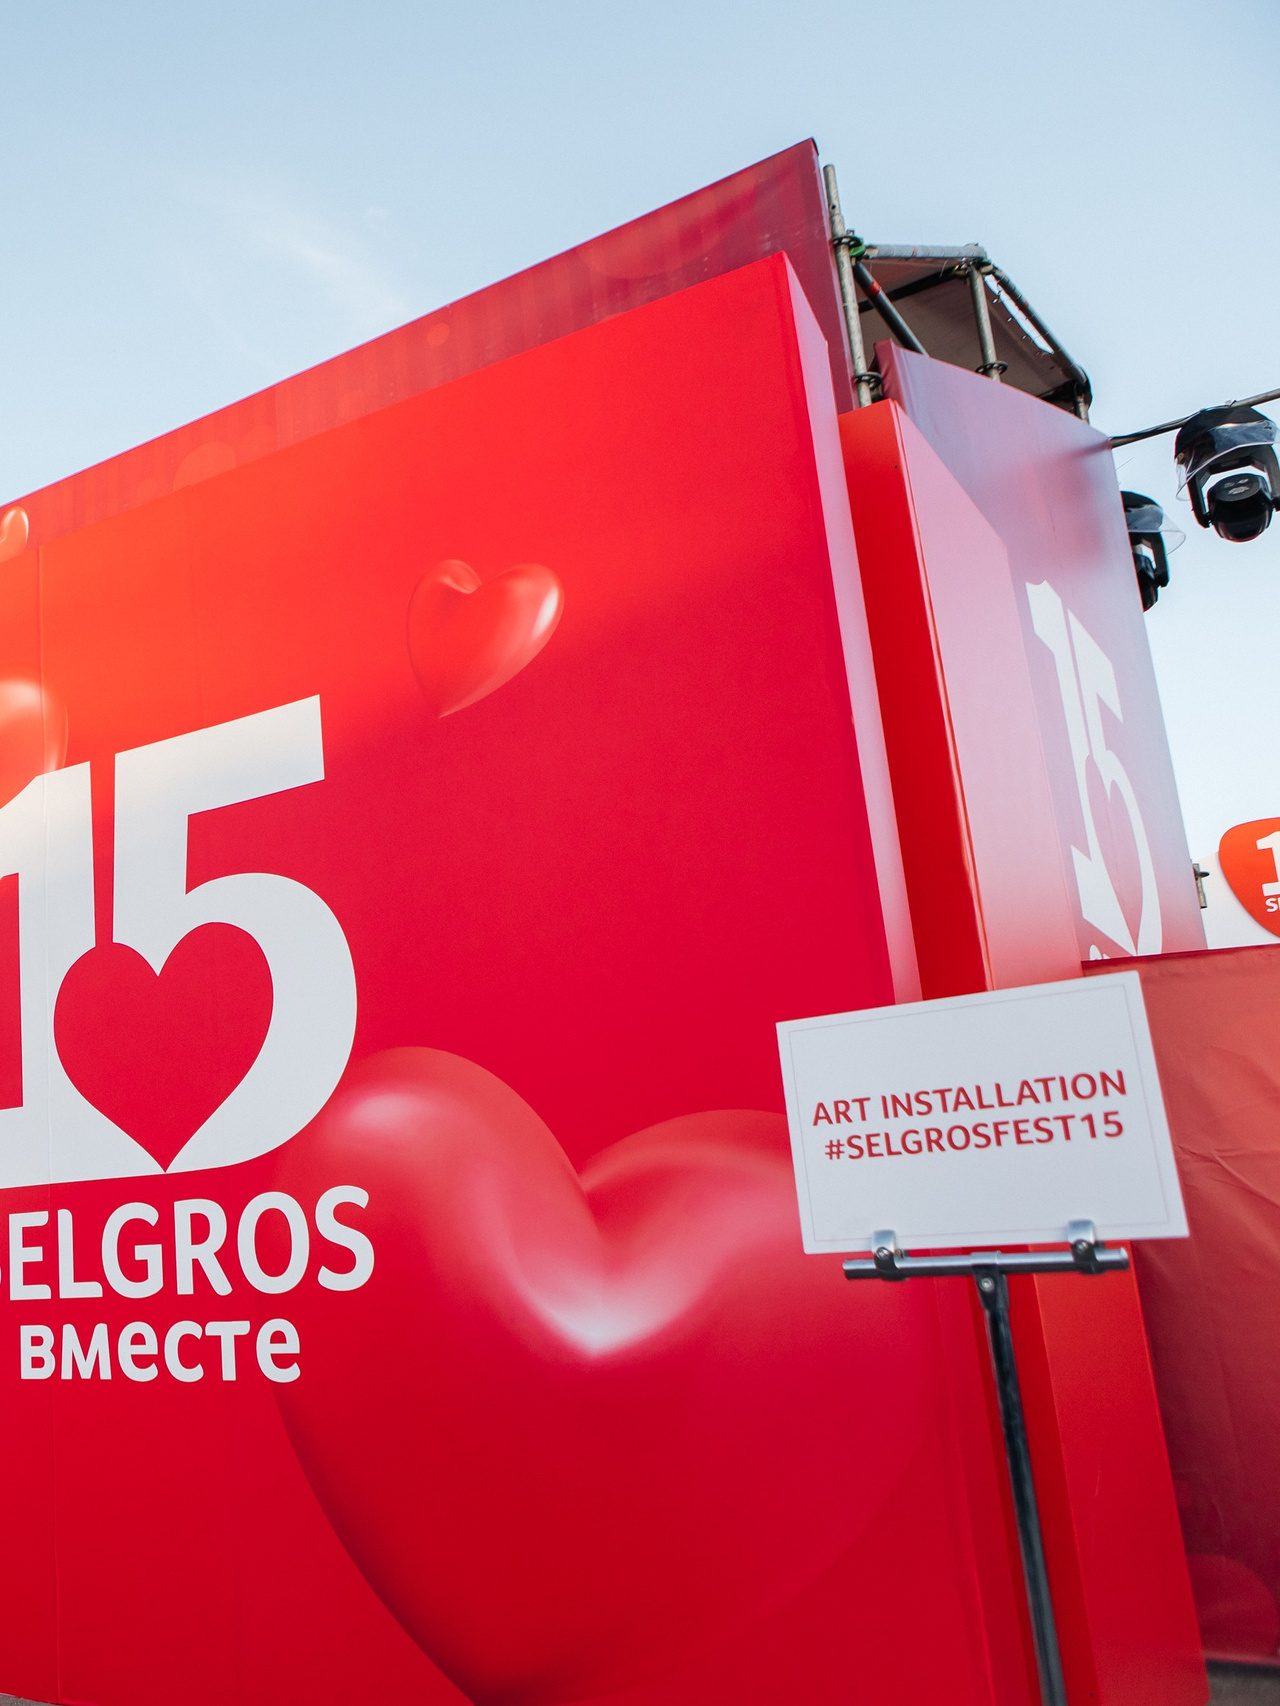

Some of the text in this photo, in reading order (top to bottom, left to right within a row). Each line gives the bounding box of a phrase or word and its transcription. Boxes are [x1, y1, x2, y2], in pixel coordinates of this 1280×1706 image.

[812, 1069, 1127, 1127] ART INSTALLATION
[825, 1110, 1124, 1161] #SELGROSFEST15
